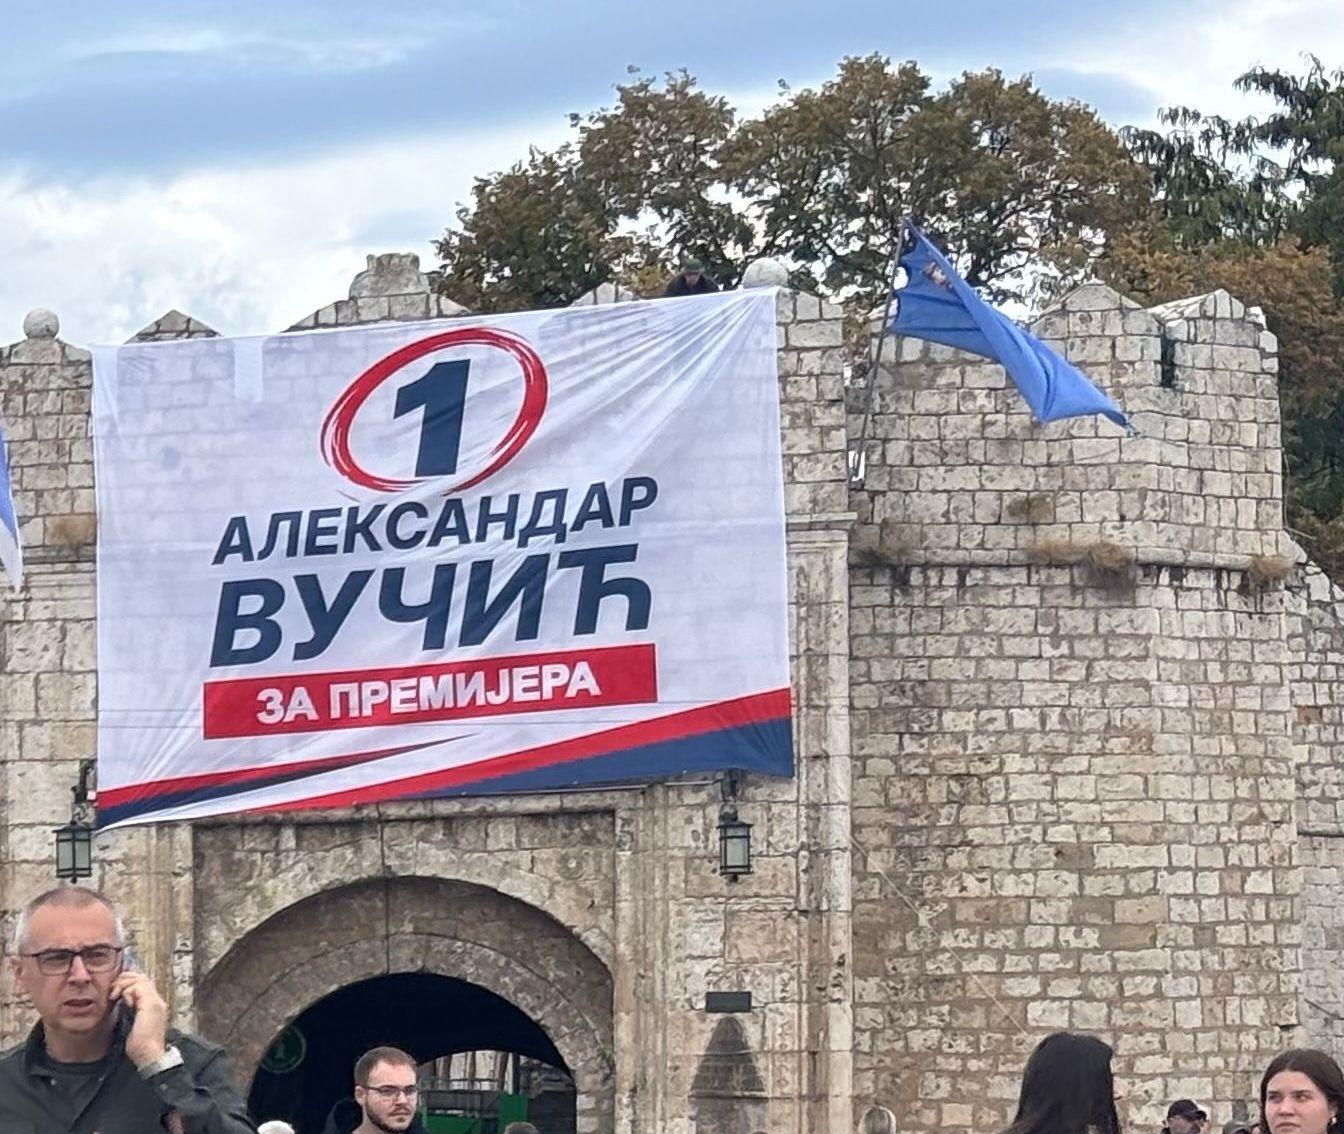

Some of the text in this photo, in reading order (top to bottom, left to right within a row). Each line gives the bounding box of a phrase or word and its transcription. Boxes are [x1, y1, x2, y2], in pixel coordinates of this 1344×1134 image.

[393, 358, 471, 477] 1
[211, 476, 659, 566] АЛЕКСАНДАР
[210, 542, 653, 668] ВУЧИЋ
[256, 660, 603, 725] ЗА ПРЕМИЈЕРА
